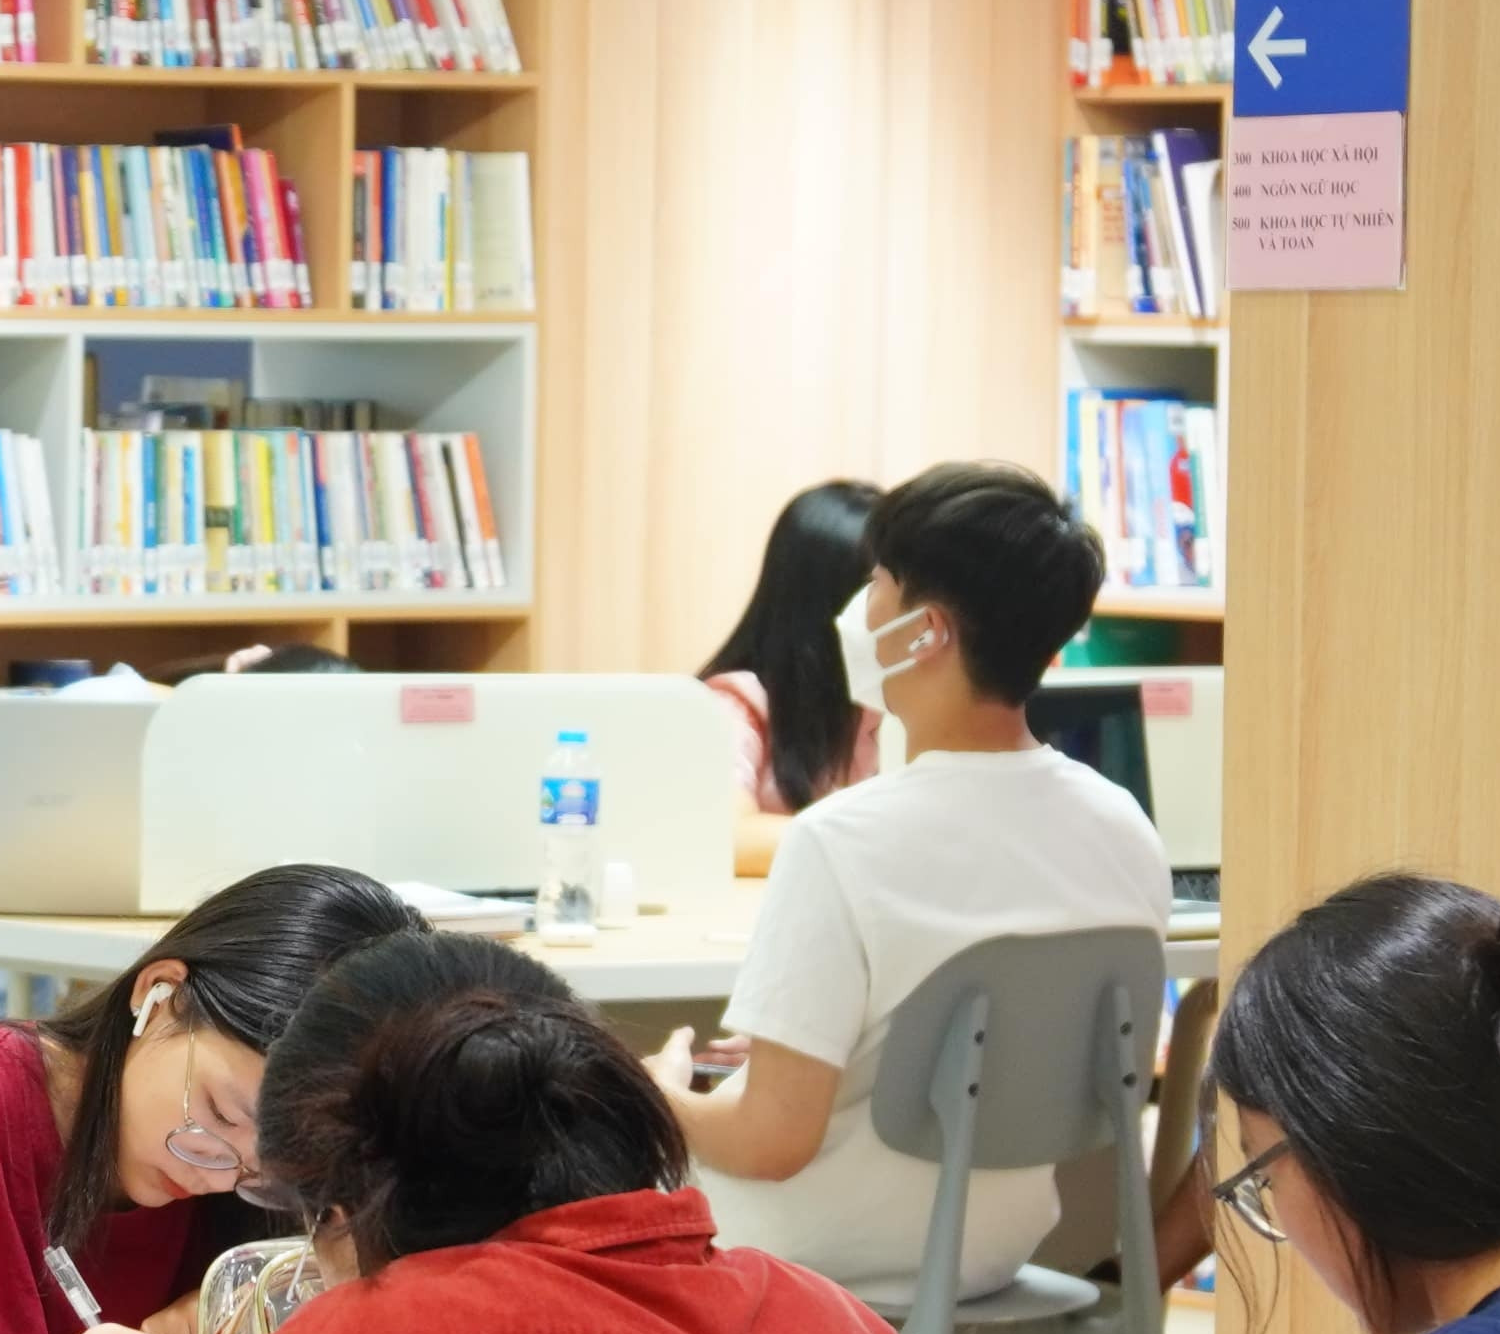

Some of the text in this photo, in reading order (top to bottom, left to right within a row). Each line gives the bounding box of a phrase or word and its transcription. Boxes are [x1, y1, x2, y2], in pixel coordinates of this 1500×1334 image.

[1233, 152, 1251, 165] 300
[1262, 150, 1298, 165] KHOA
[1301, 148, 1328, 166] HỌC
[1233, 185, 1251, 198] 400
[1331, 181, 1360, 198] HỌC
[1232, 217, 1250, 230] 500
[1260, 215, 1297, 230] KHOA
[1301, 214, 1328, 231] HỌC
[1353, 208, 1395, 227] NHIÊN
